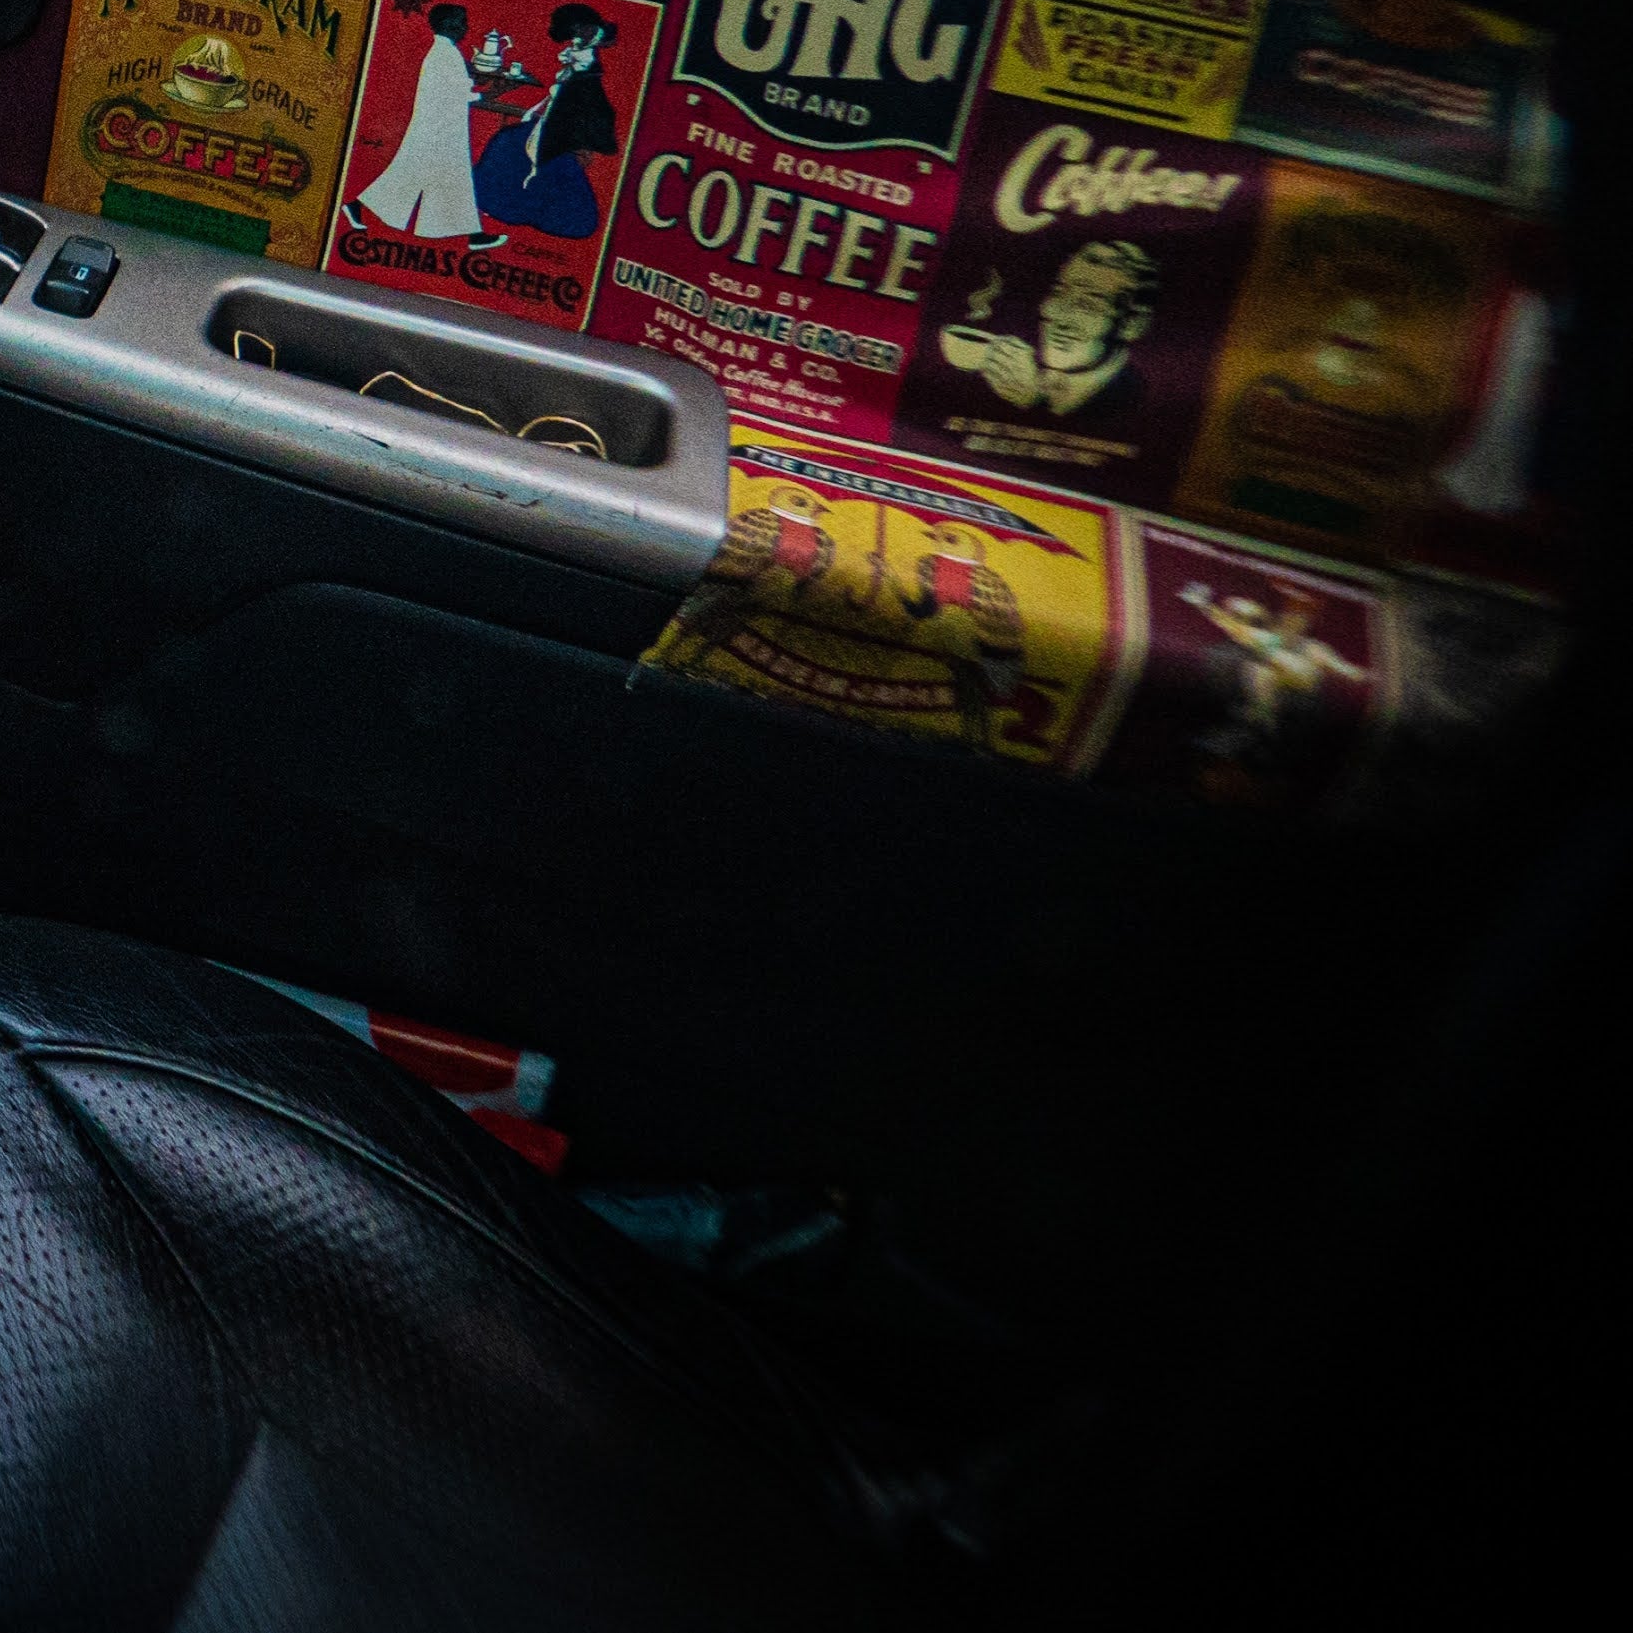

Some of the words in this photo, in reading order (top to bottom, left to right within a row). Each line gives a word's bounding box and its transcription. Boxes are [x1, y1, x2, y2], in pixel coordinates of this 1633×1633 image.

[177, 0, 263, 37] BRAND
[108, 56, 163, 88] HIGH
[251, 78, 319, 131] GRADE
[764, 81, 872, 127] BRAND
[102, 105, 300, 189] COFFEE
[687, 122, 757, 164] FINE
[772, 151, 914, 207] ROASTED
[636, 151, 938, 303] COFFEE
[458, 249, 551, 303] COFFEE
[613, 257, 708, 317] UNITED
[708, 296, 795, 346] HOME
[707, 271, 763, 300] SOLD
[776, 290, 814, 312] BY
[653, 306, 760, 362] HULMAN
[768, 352, 789, 371] &
[799, 360, 843, 384] CO.
